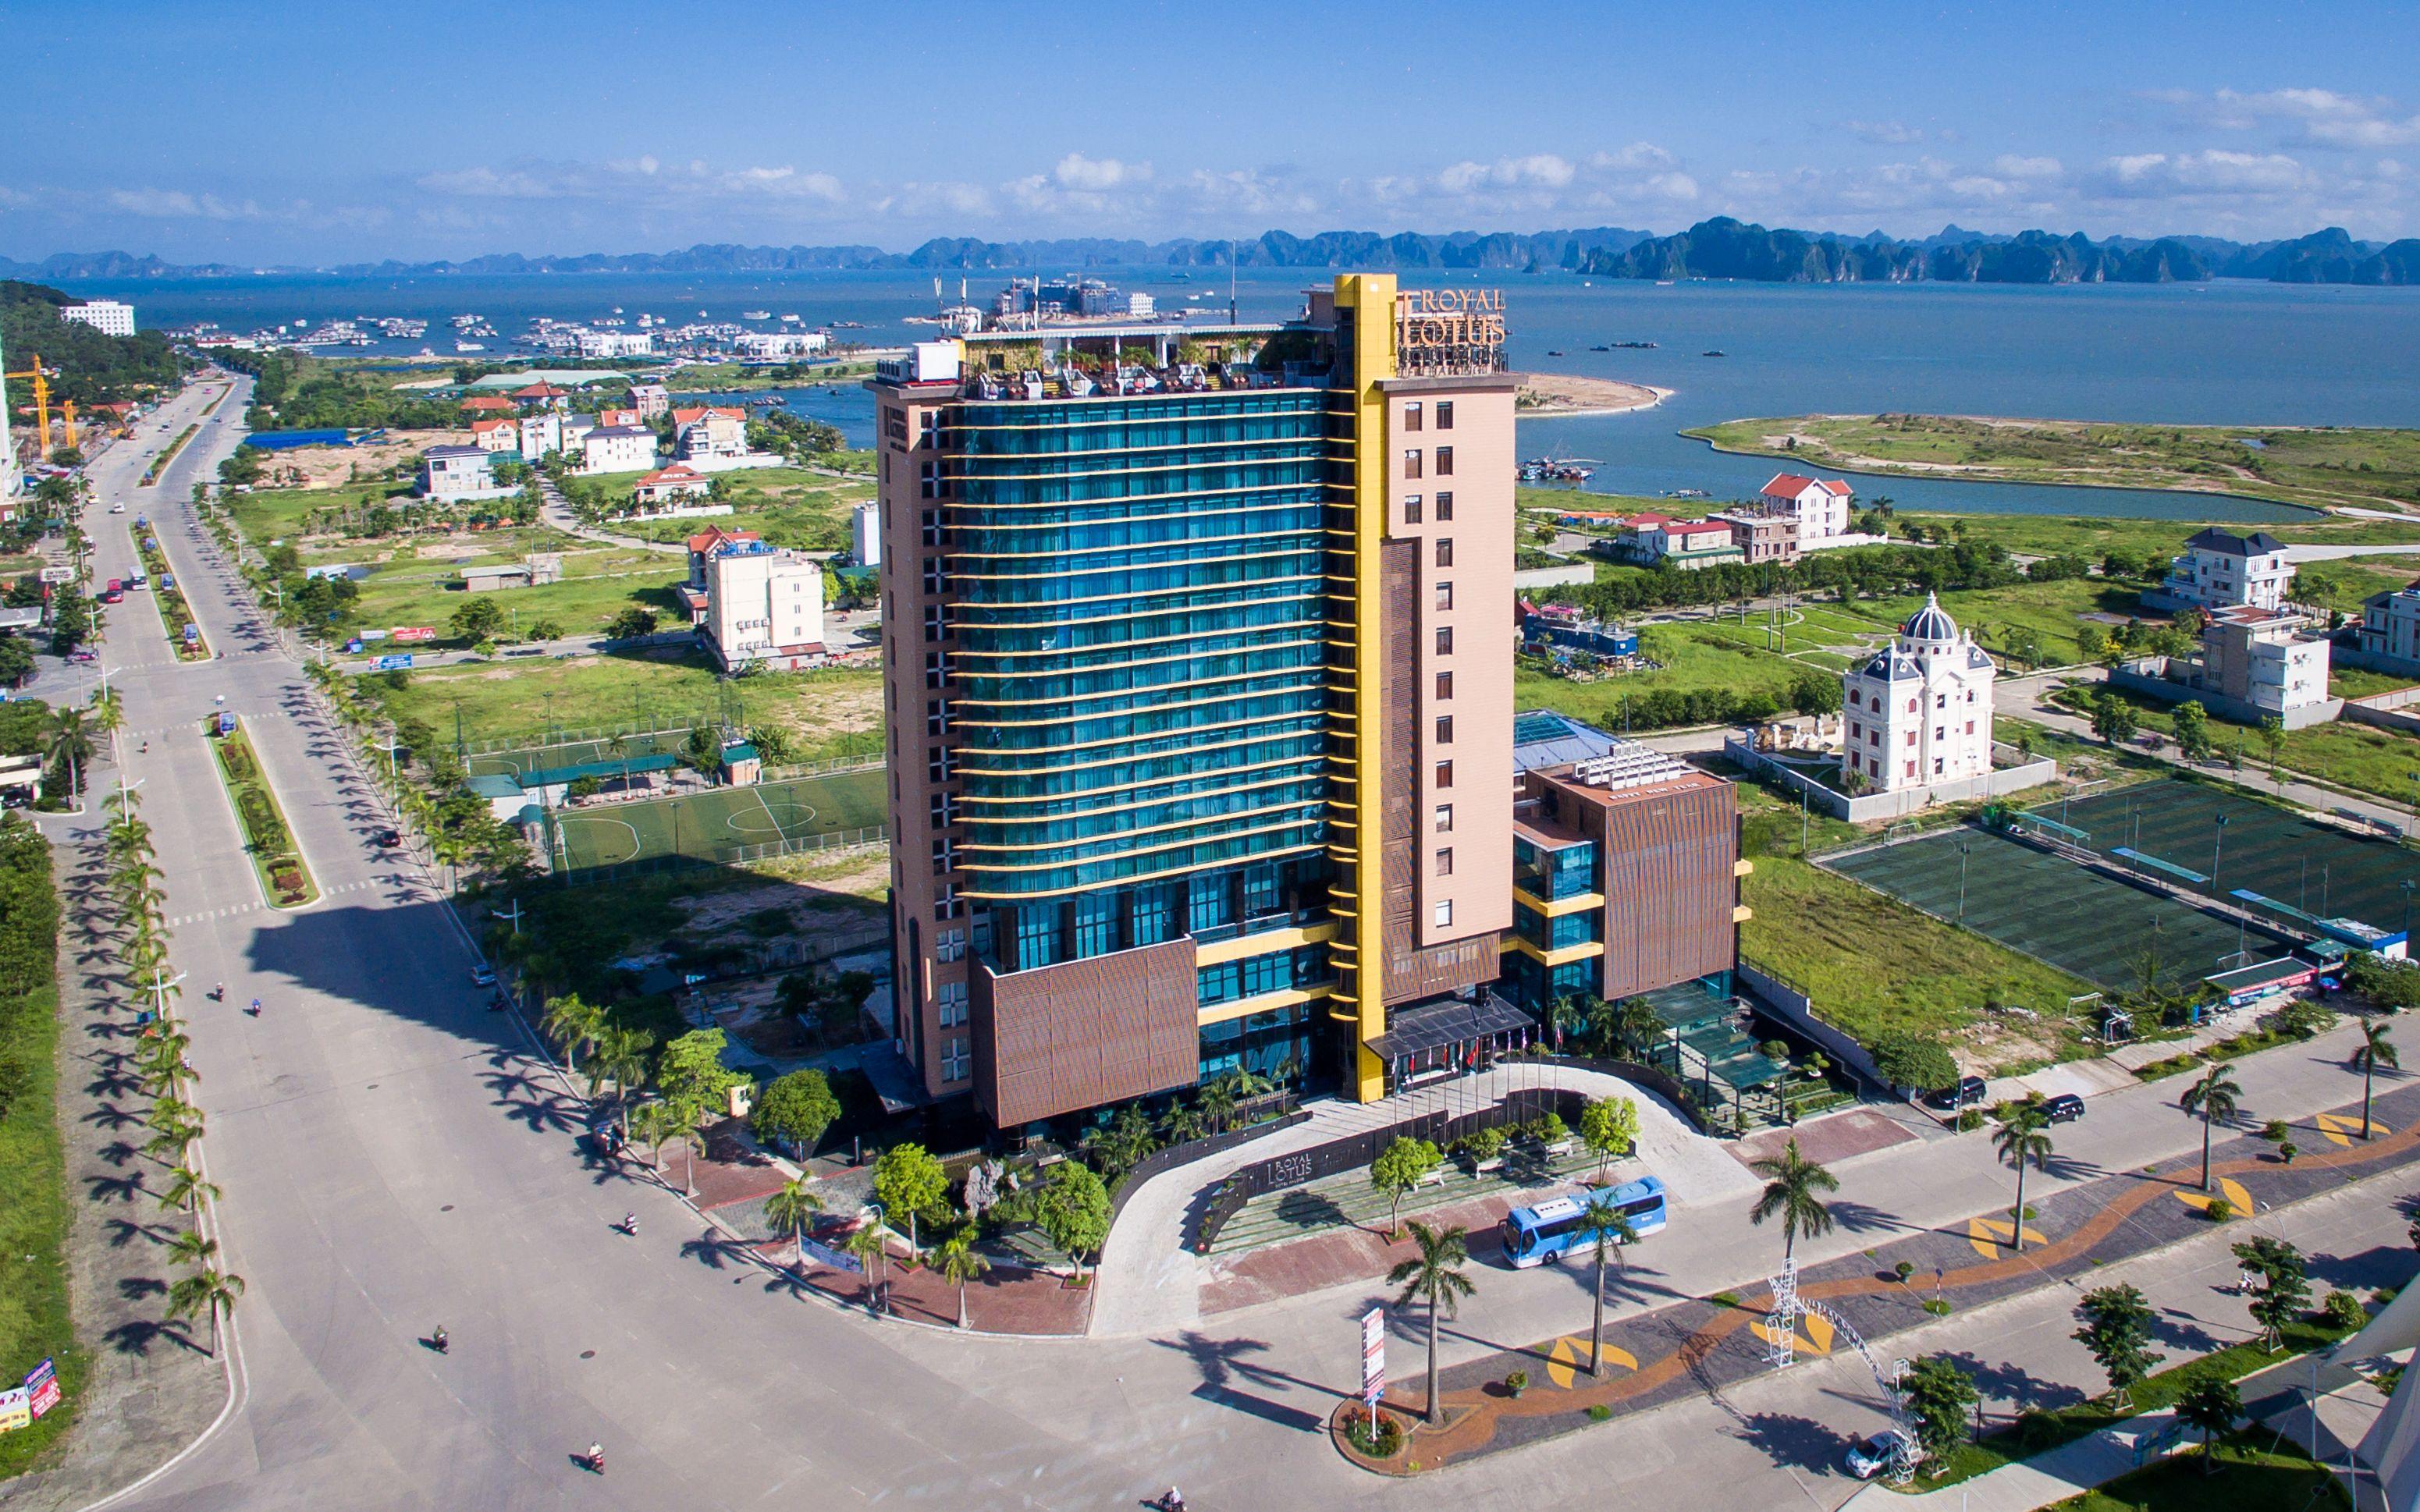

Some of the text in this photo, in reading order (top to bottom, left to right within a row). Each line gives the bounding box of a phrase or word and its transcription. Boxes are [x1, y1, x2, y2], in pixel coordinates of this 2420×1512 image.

[1422, 289, 1505, 311] ROYAL
[1403, 291, 1505, 347] LOTUS
[1275, 1153, 1312, 1171] ROYAL
[1267, 1162, 1312, 1185] LOTUS
